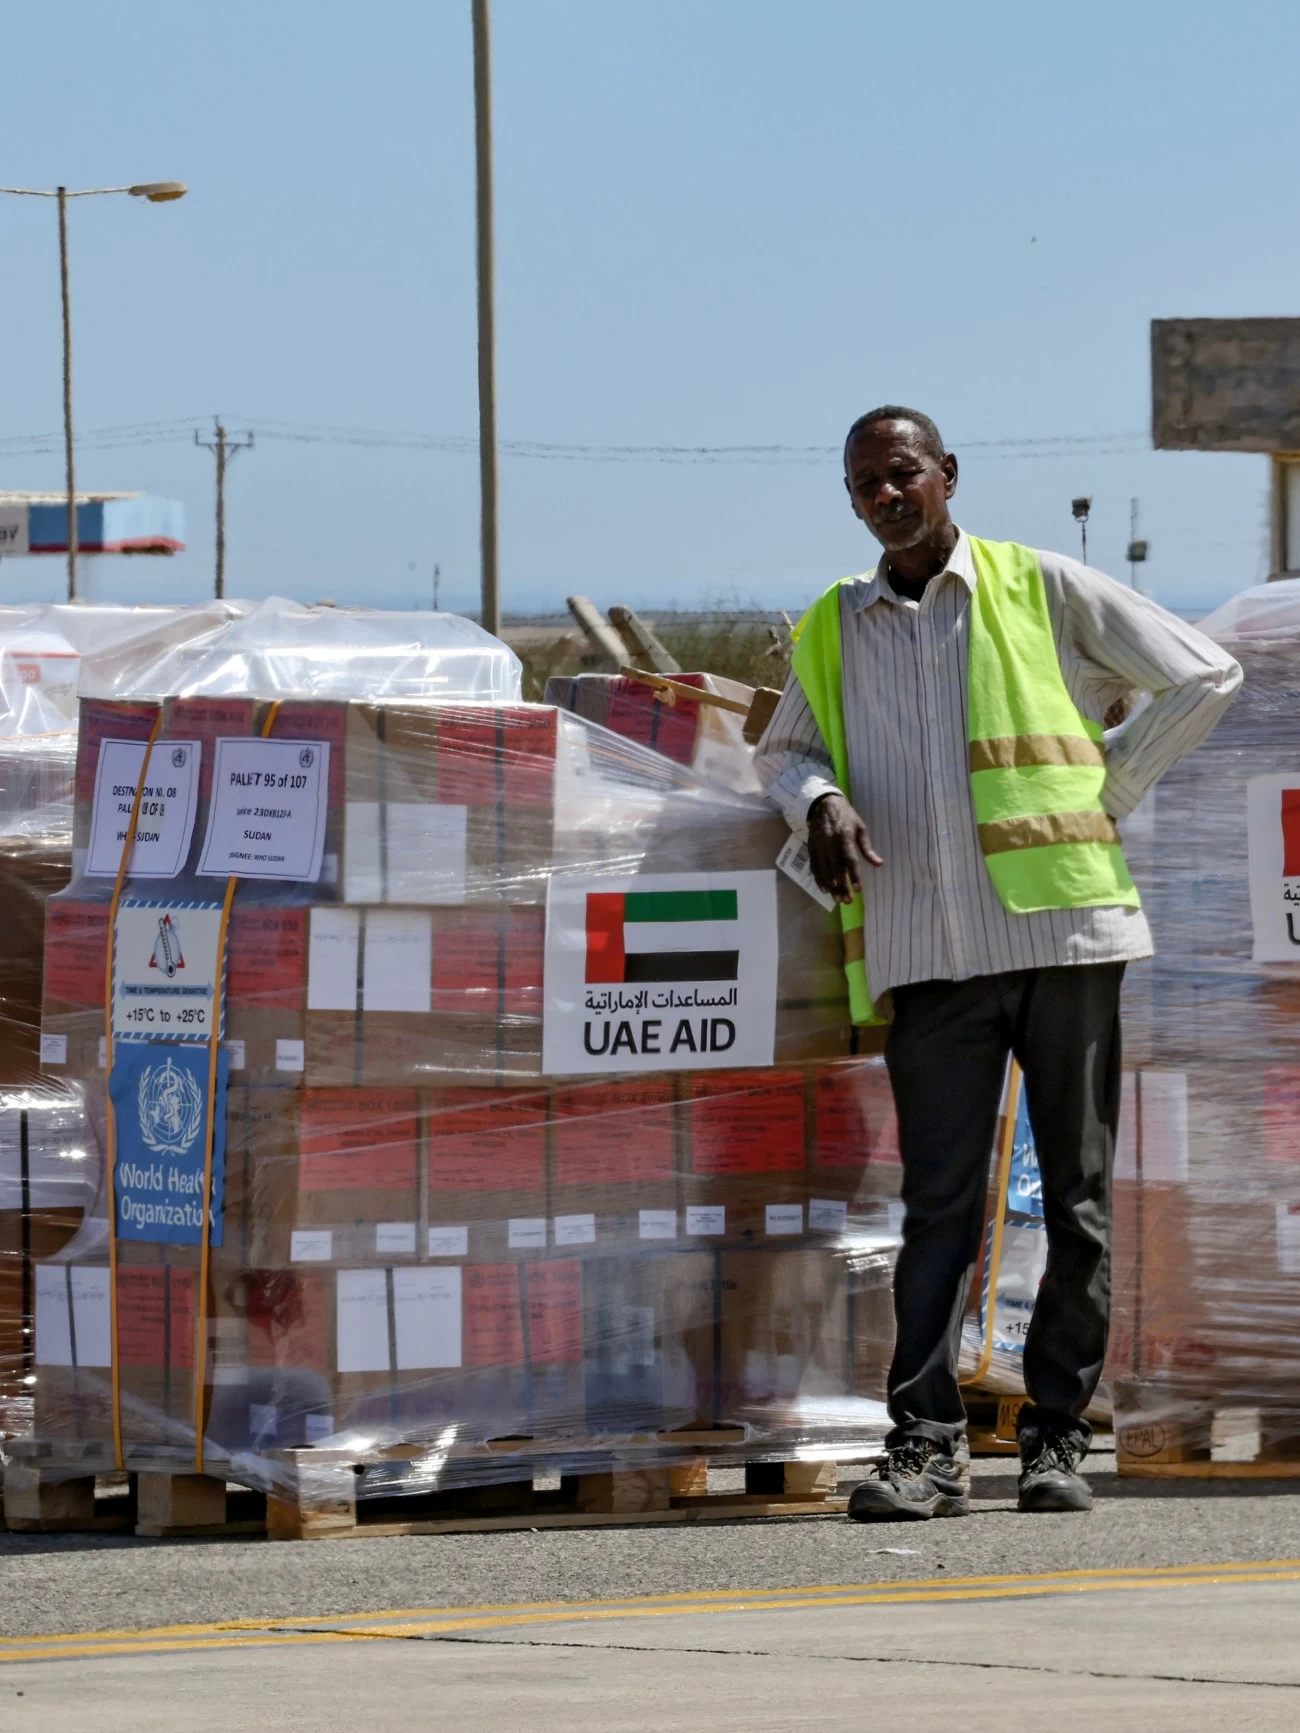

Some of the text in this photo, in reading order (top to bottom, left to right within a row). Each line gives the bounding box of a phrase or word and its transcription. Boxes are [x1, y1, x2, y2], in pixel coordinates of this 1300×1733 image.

[264, 773, 276, 787] 95
[278, 774, 289, 788] of
[290, 775, 307, 789] 107
[243, 830, 272, 841] SUDAN
[585, 988, 738, 1015] المساعدات الإماراتية
[160, 1009, 171, 1022] to
[584, 1018, 736, 1056] UAE AID
[120, 1163, 163, 1191] World
[1005, 1321, 1030, 1336] +15
